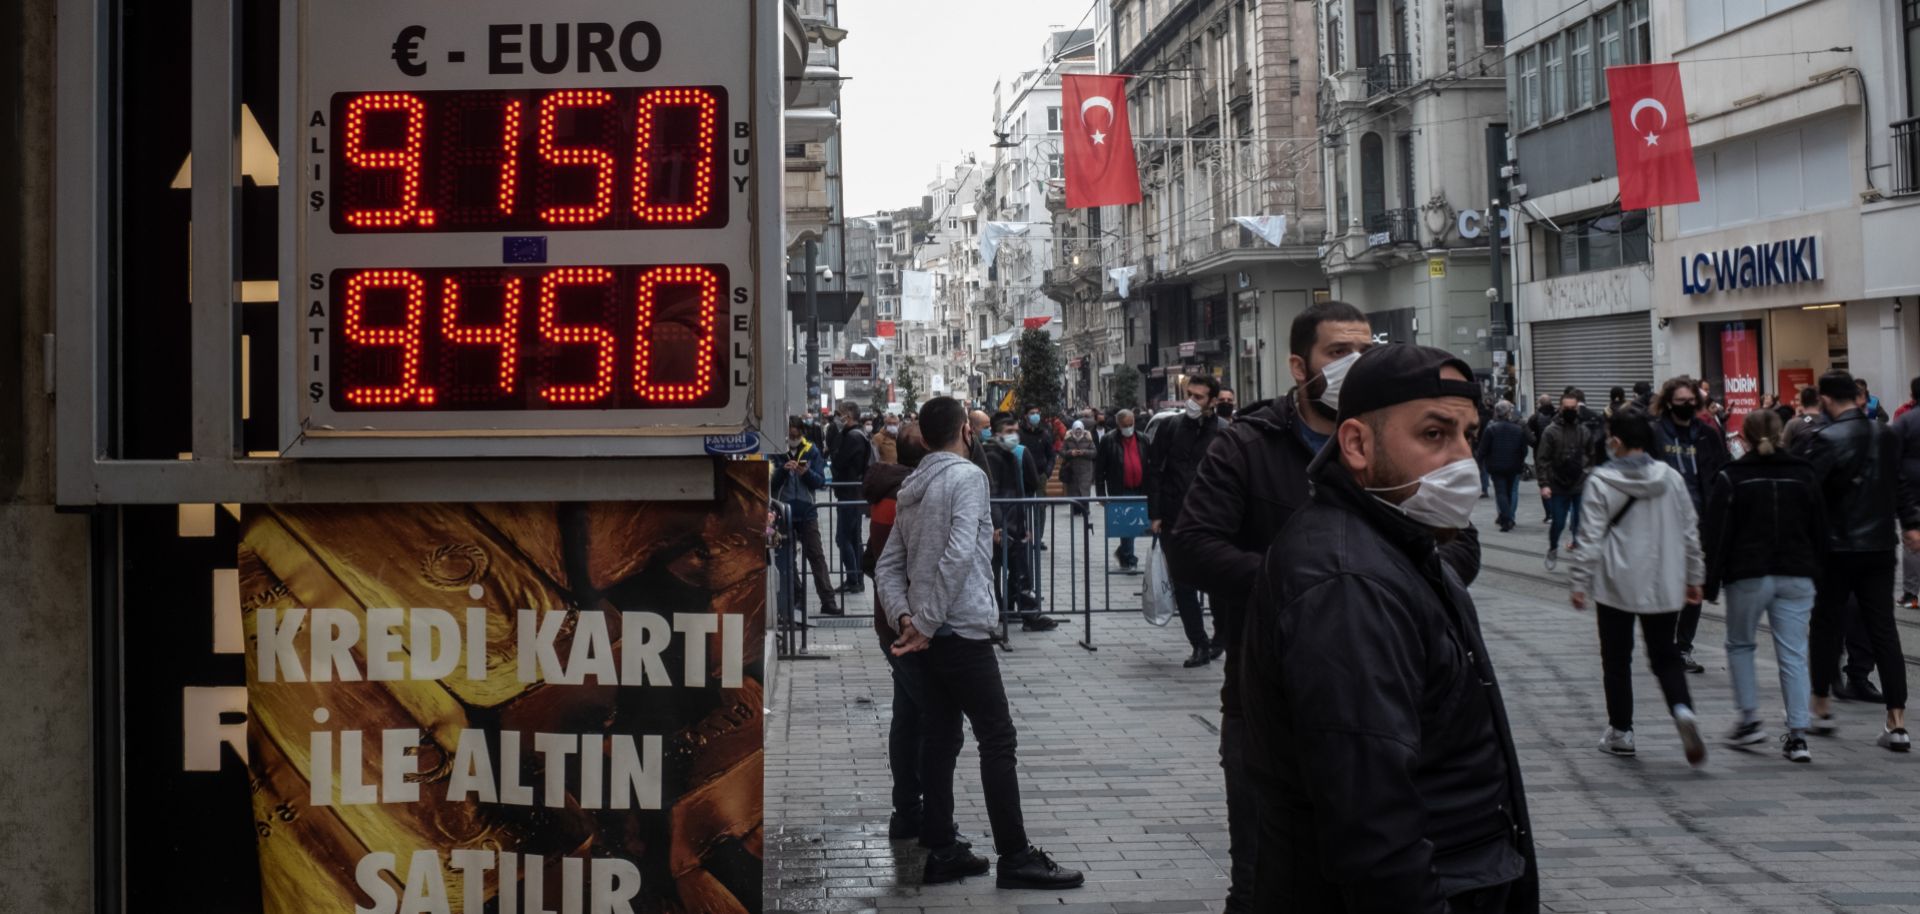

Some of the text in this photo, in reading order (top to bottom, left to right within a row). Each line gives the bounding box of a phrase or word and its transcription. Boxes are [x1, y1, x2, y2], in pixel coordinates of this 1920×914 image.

[391, 25, 427, 76] €
[488, 21, 662, 74] EURO
[309, 110, 326, 211] ALIŞ
[344, 87, 717, 227] 9.150
[733, 121, 750, 193] BUY
[309, 272, 326, 403] SATIŞ
[344, 265, 717, 405] 9.450
[733, 287, 748, 386] SELL
[1724, 374, 1757, 392] İNDİRİM
[257, 583, 744, 689] KREDİ KARTI
[310, 707, 663, 810] İLE ALTIN
[355, 850, 642, 914] SATILIR
